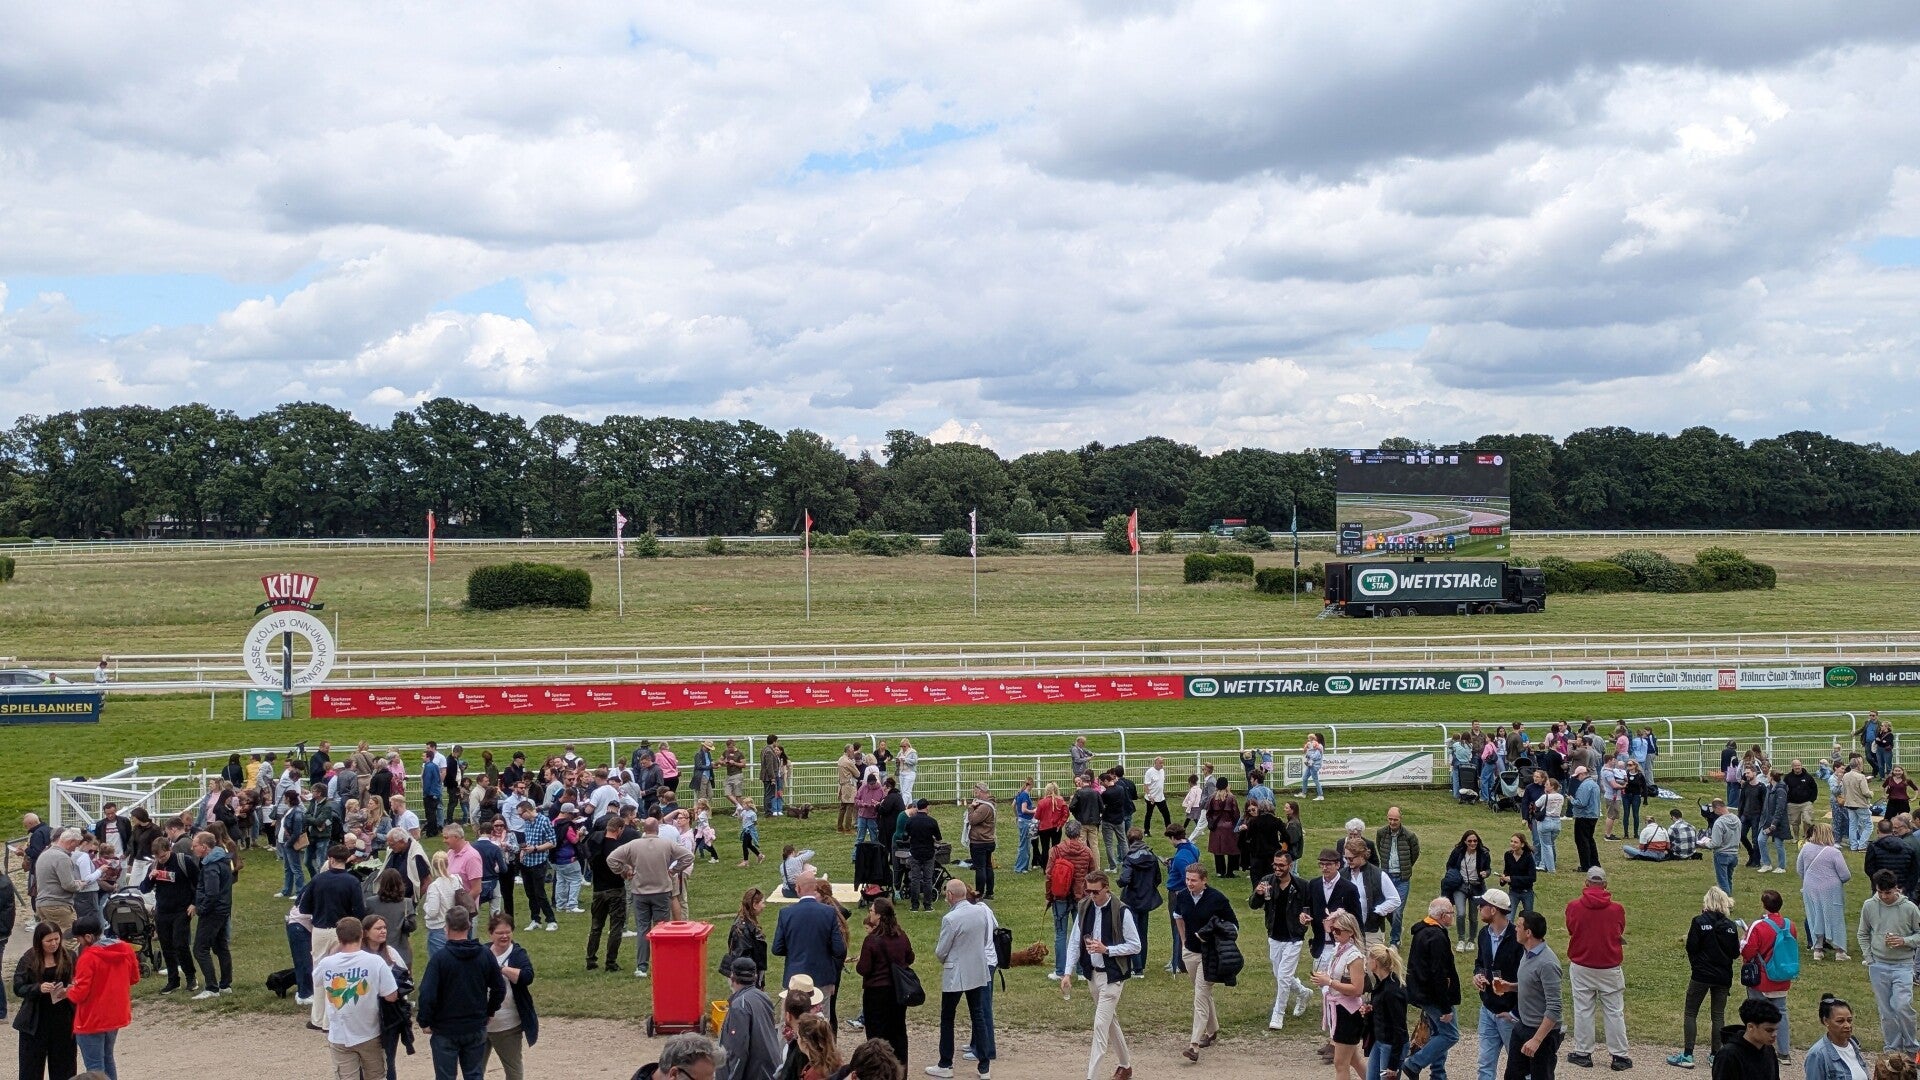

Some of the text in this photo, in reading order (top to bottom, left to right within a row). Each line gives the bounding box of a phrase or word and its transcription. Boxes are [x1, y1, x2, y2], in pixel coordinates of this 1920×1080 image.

[266, 574, 314, 598] KÖLN
[1400, 574, 1497, 588] WETTSTAR.de
[1360, 678, 1450, 690] WETTSTAR.de
[1870, 673, 1884, 682] Hol
[1886, 672, 1897, 680] dir
[1224, 680, 1319, 694] WETTSTAR.de
[0, 704, 92, 713] SPIELBANKEN
[325, 967, 368, 981] Sevilla
